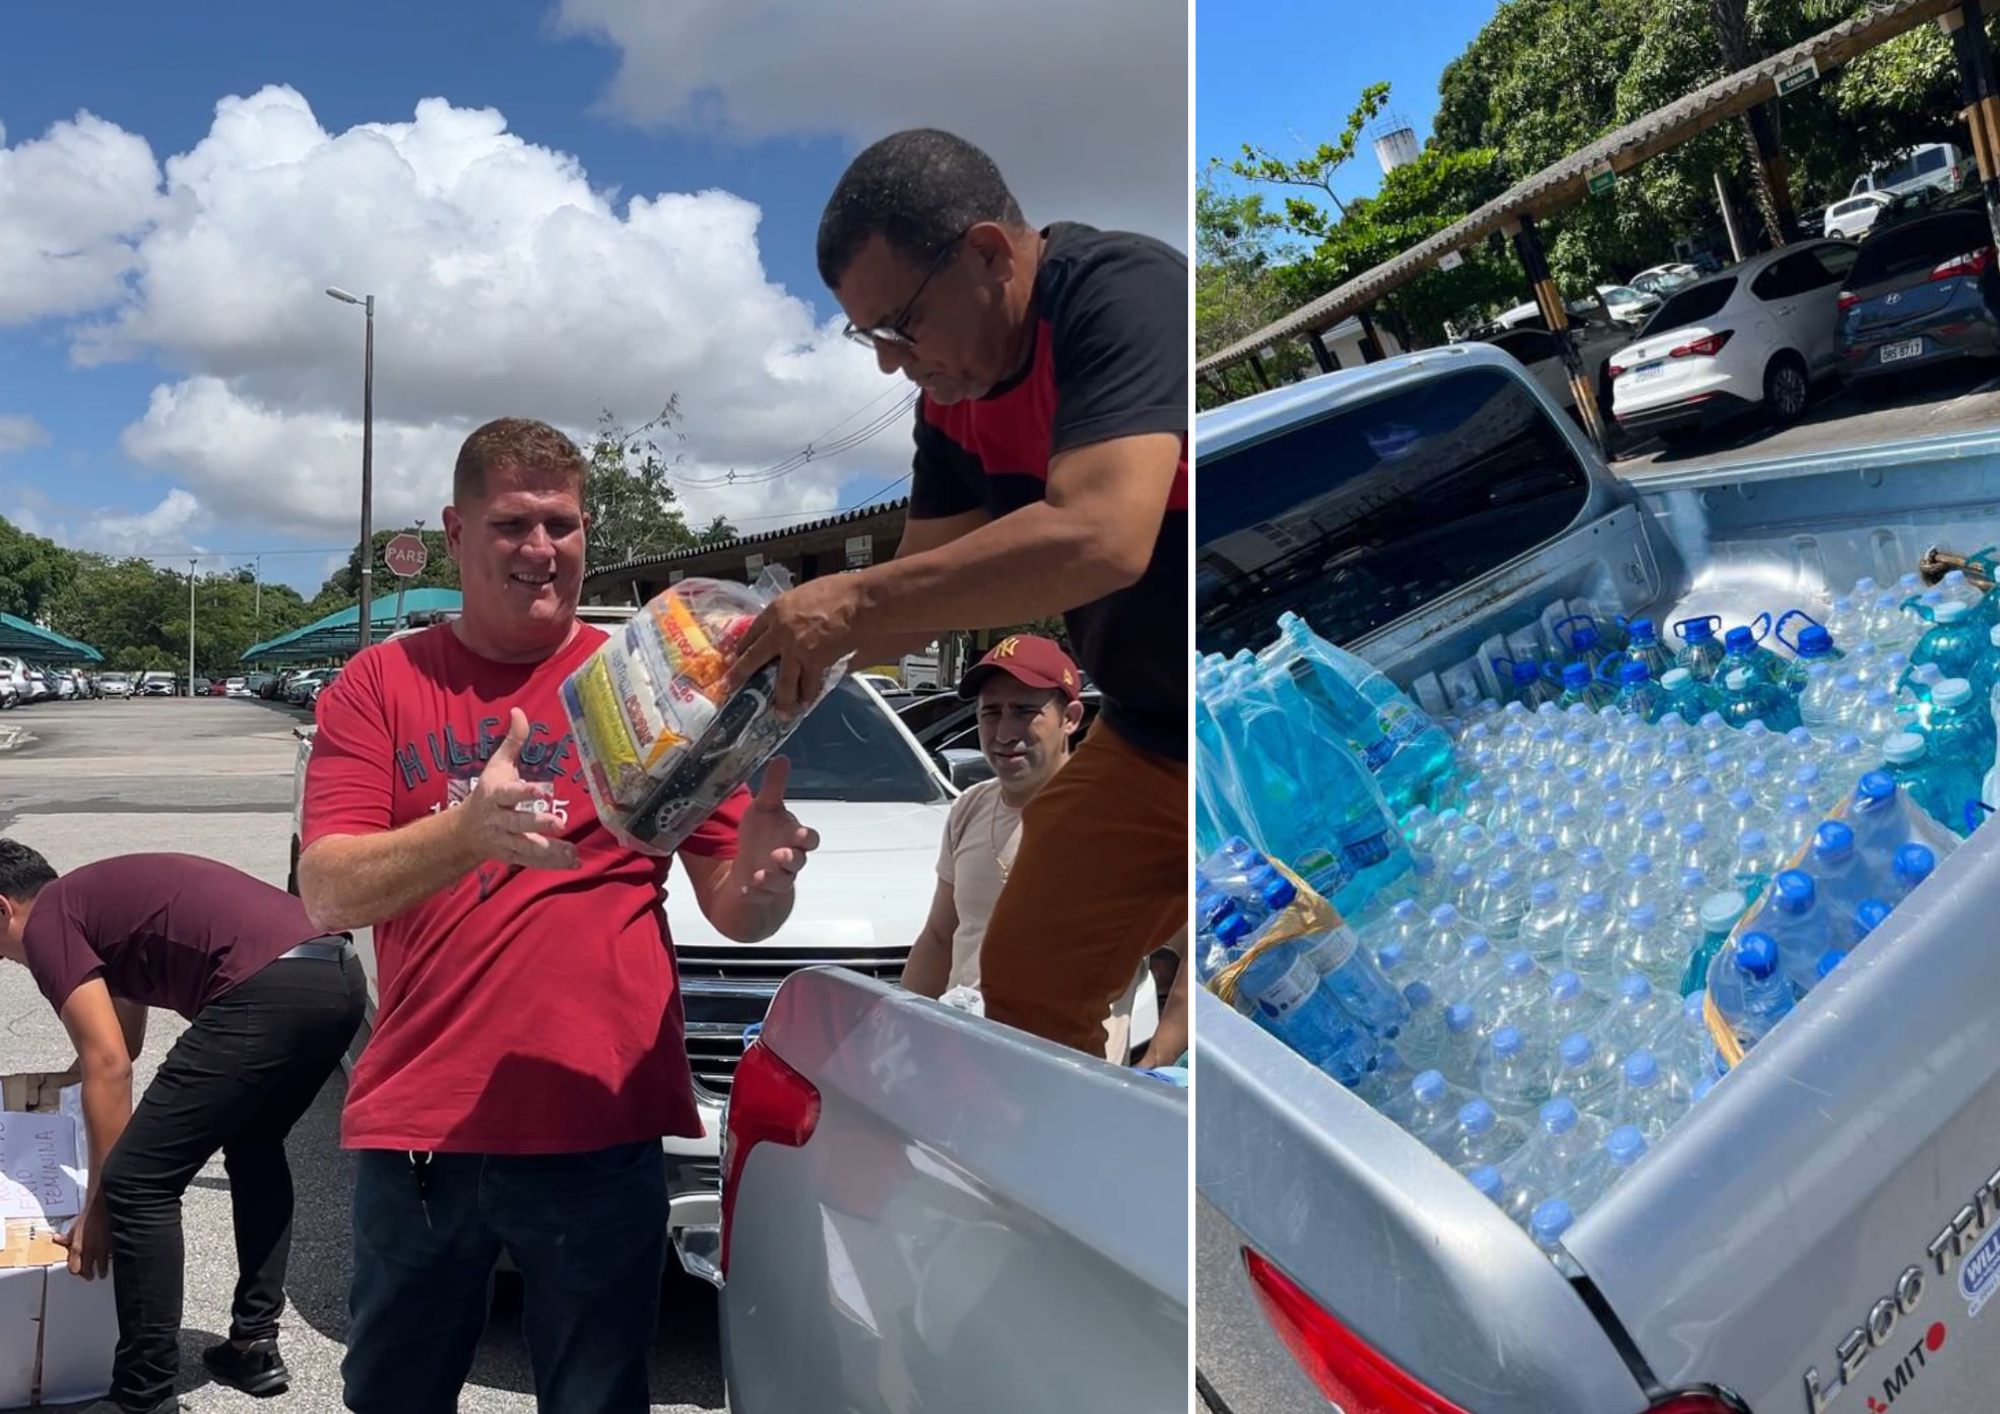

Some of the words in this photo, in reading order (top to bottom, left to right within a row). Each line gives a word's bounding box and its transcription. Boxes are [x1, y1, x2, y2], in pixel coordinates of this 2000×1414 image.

[387, 547, 425, 564] PARE
[993, 637, 1020, 660] NY
[396, 717, 589, 792] HILFGE
[15, 1169, 38, 1211] FRIO
[35, 1129, 65, 1206] FEMININA
[1804, 1264, 1925, 1414] L200
